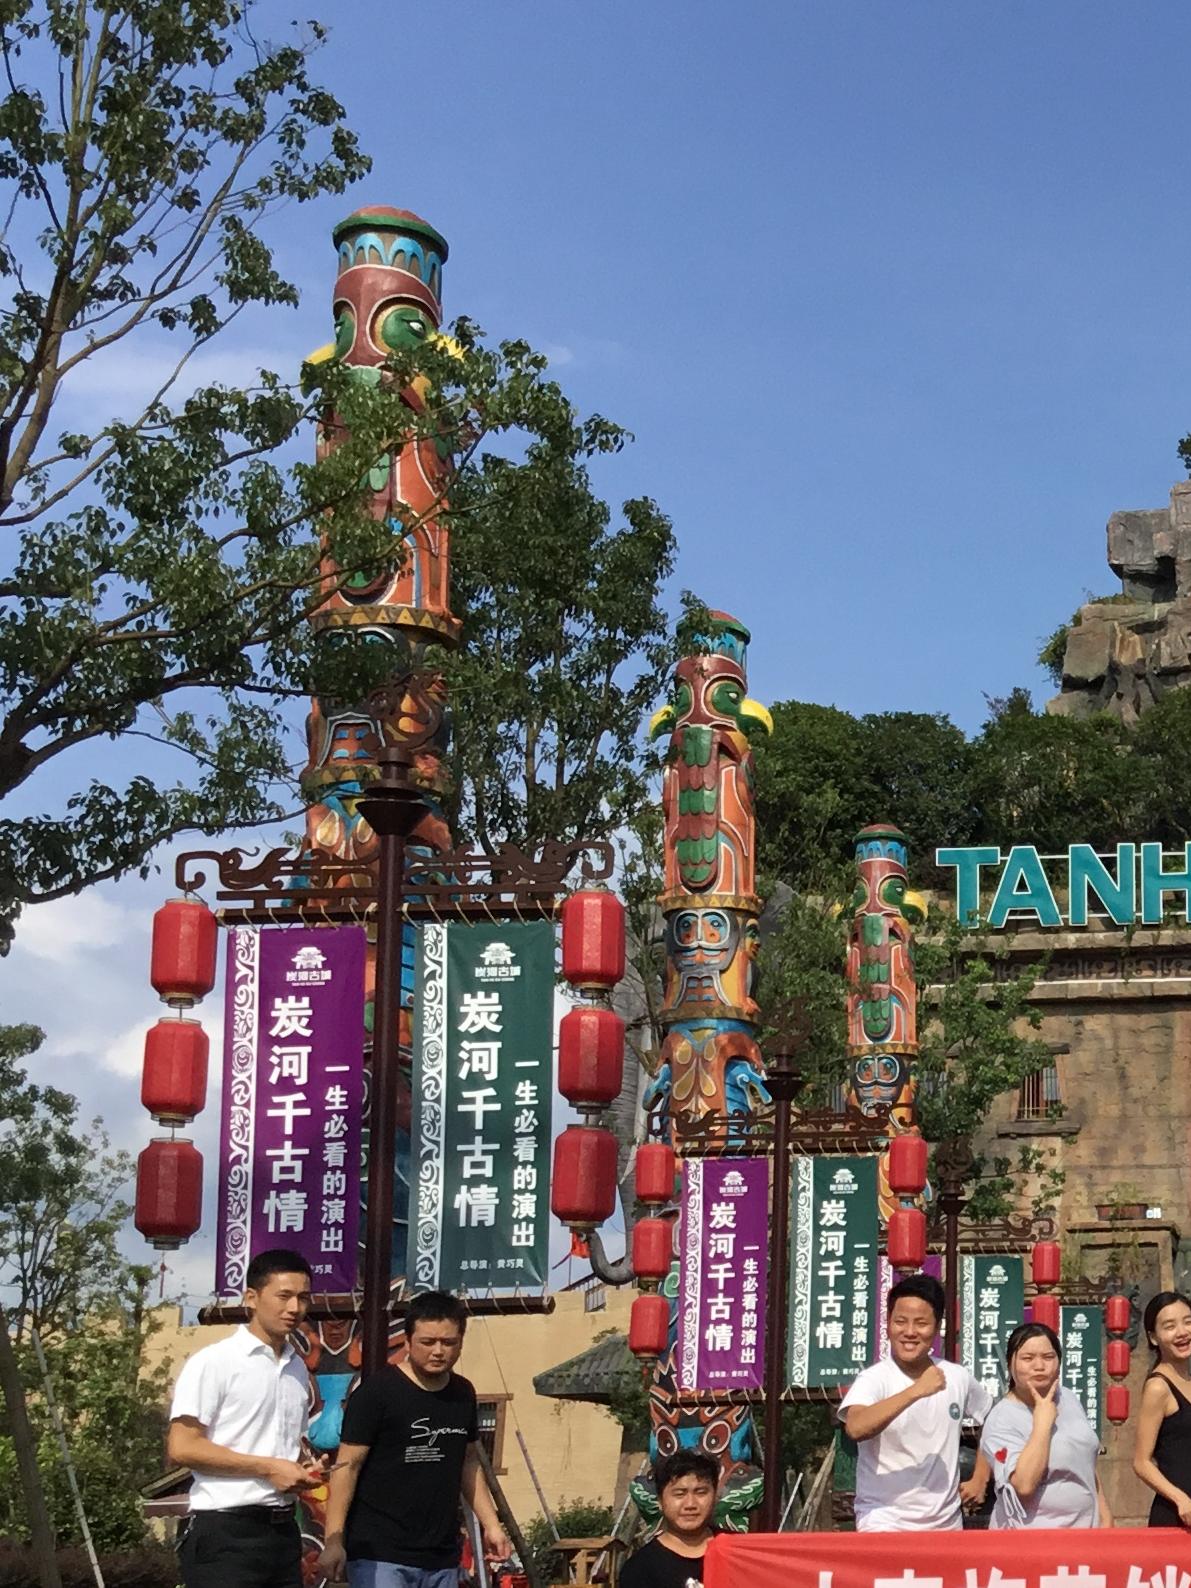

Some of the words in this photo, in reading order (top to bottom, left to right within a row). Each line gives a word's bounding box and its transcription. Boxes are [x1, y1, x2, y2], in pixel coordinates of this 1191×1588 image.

[262, 995, 314, 1234] 炭河千古情
[320, 1065, 350, 1253] 一生必看的演出
[453, 990, 503, 1228] 炭河千古情
[511, 1060, 541, 1248] 一生必看的演出
[705, 1202, 737, 1351] 炭河千古情
[740, 1245, 760, 1364] 一生必看的演出
[816, 1200, 847, 1349] 炭河千古情
[852, 1243, 870, 1362] 一生必看的演出
